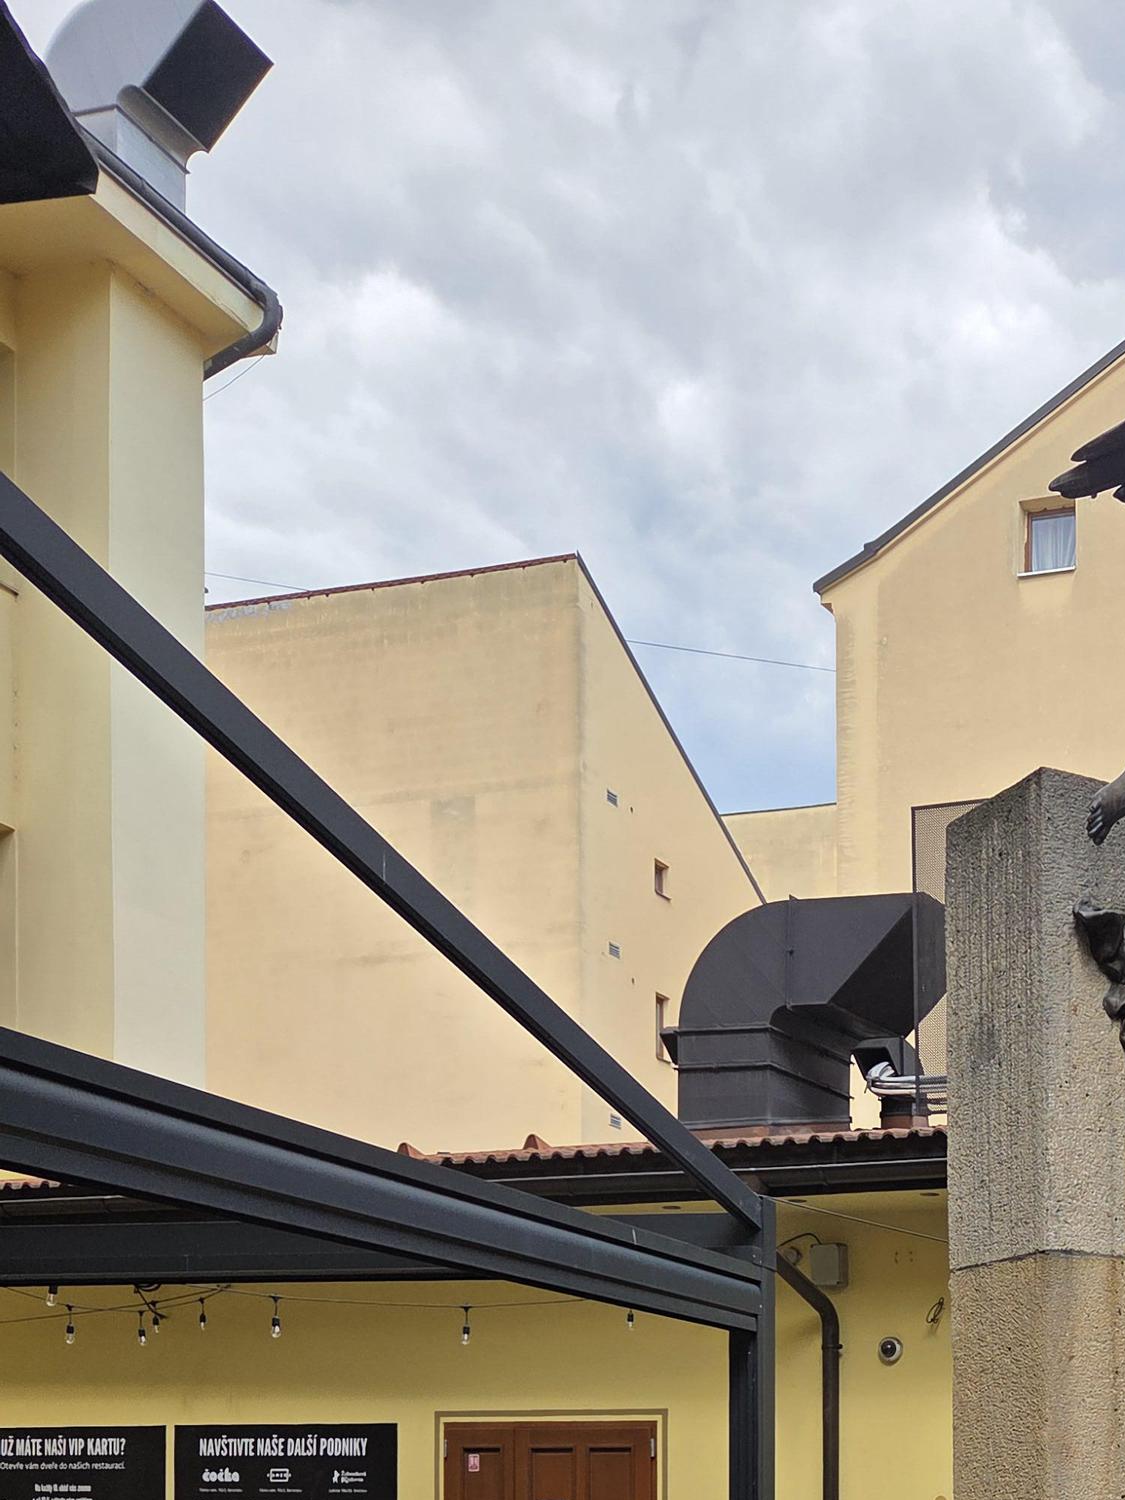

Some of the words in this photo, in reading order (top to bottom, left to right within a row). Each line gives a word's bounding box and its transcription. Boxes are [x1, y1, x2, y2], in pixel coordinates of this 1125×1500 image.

[0, 1435, 14, 1456] UŽ
[16, 1435, 43, 1456] MÁTE
[44, 1435, 67, 1456] NAŠI
[68, 1437, 85, 1456] VIP
[87, 1437, 126, 1456] KARTU?
[199, 1434, 255, 1456] NAVŠTIVTE
[257, 1434, 285, 1456] NAŠE
[286, 1434, 318, 1456] DALŠÍ
[320, 1437, 368, 1456] PODNIKY
